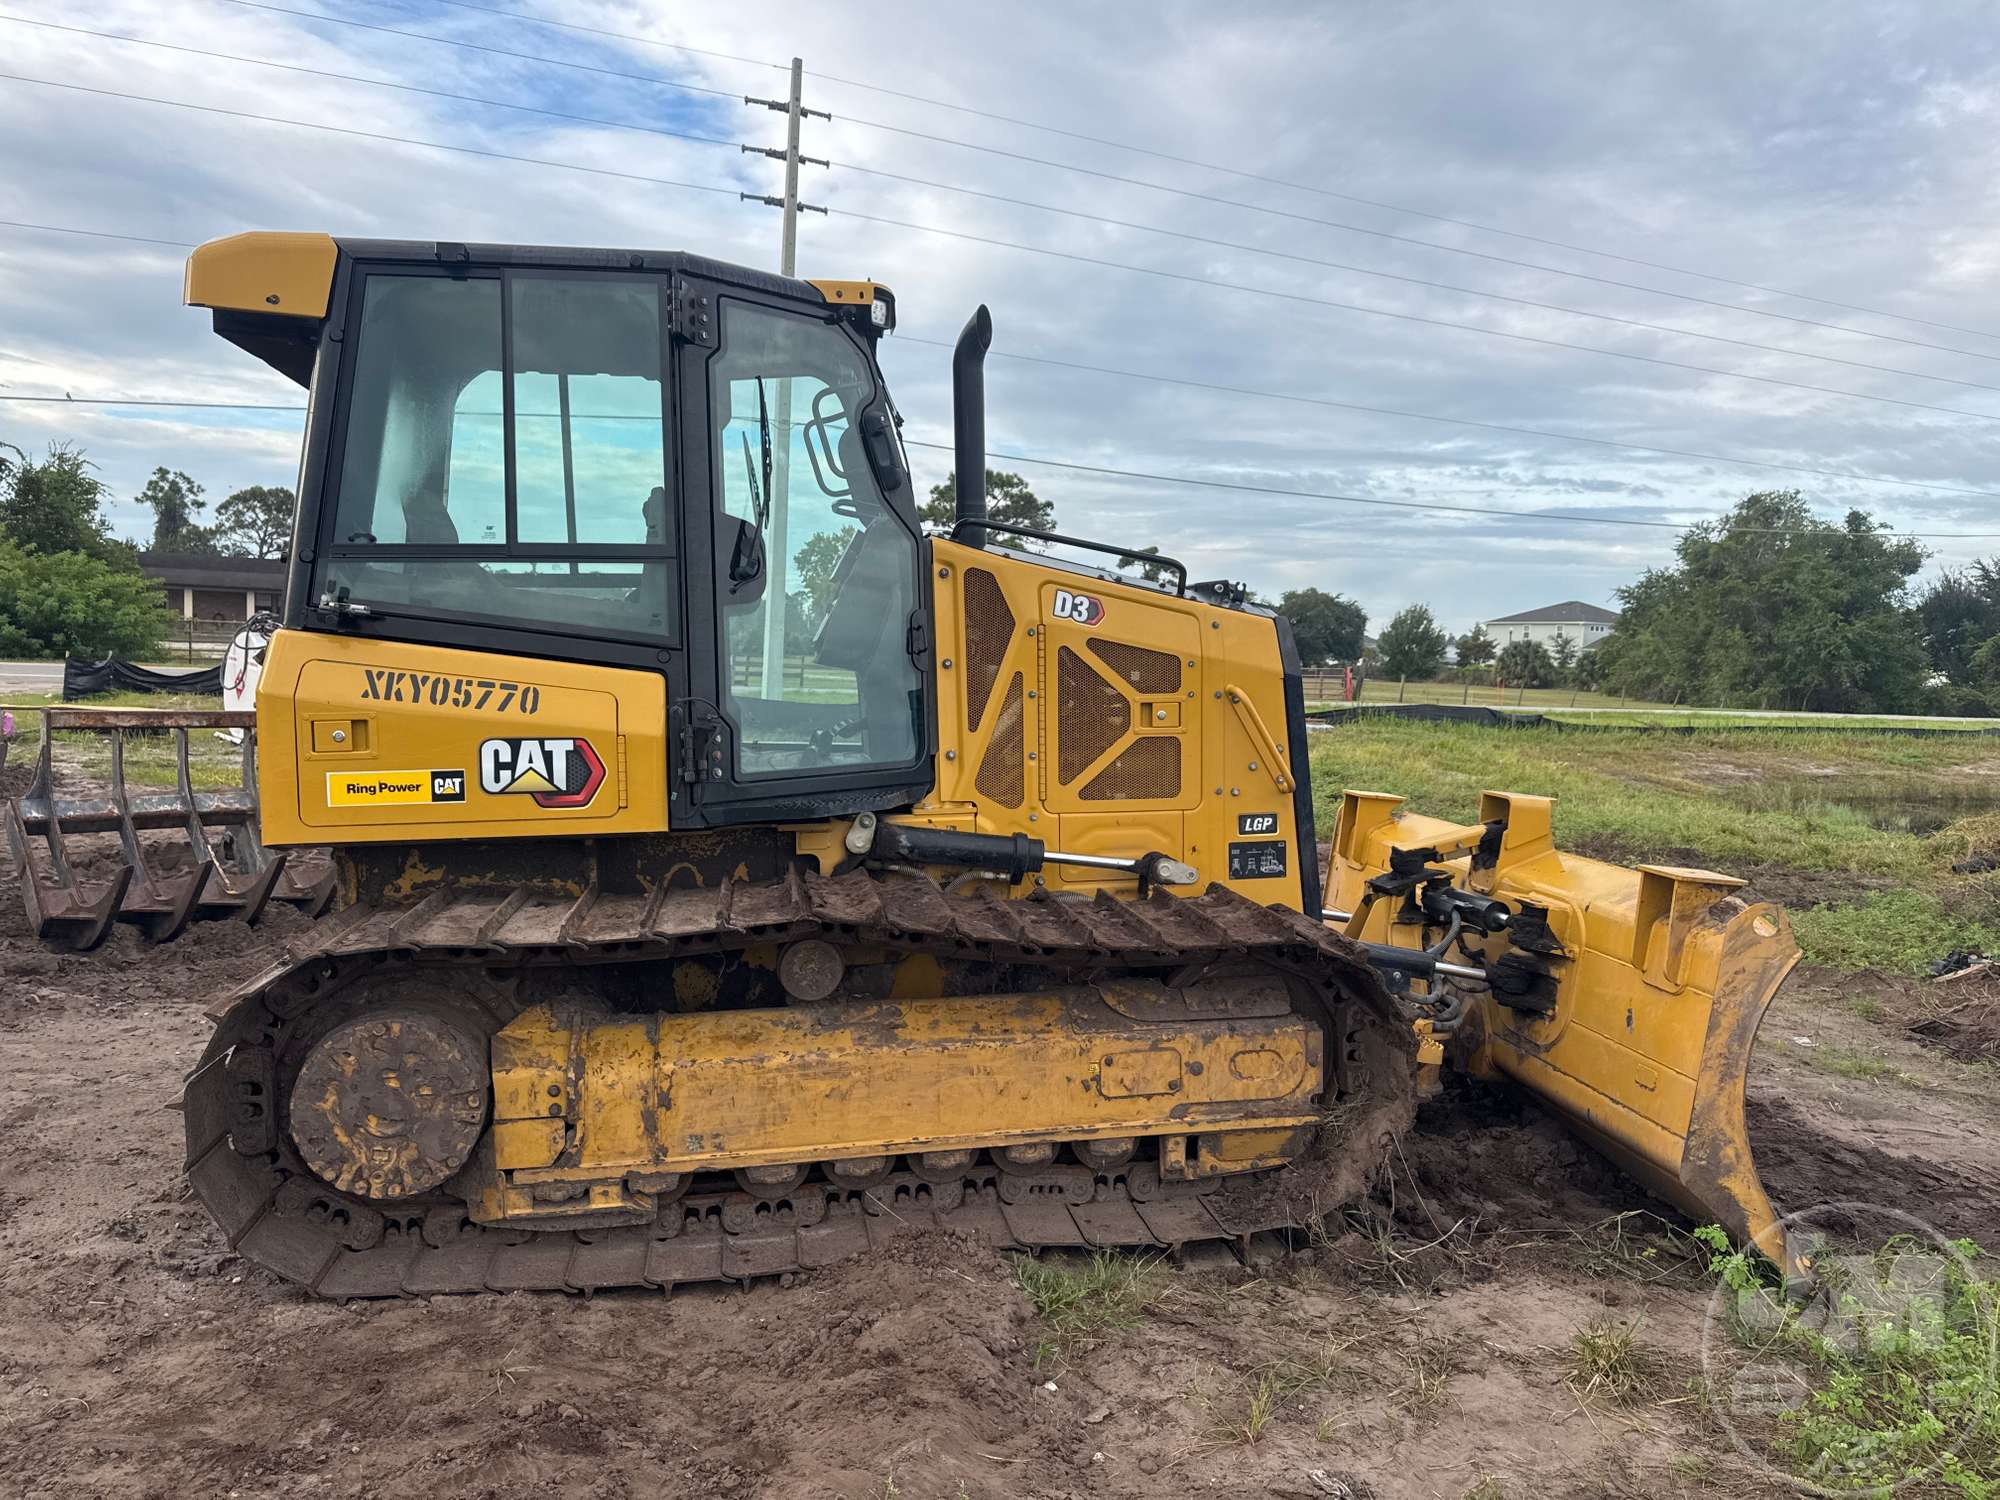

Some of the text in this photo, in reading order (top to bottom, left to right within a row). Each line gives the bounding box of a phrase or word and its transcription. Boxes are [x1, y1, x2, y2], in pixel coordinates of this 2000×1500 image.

[1054, 590, 1089, 622] D3
[361, 669, 539, 715] XKY05770
[481, 739, 574, 792] CAT
[346, 781, 422, 796] Ring Power
[434, 778, 463, 795] CAT
[1245, 817, 1273, 832] LGP
